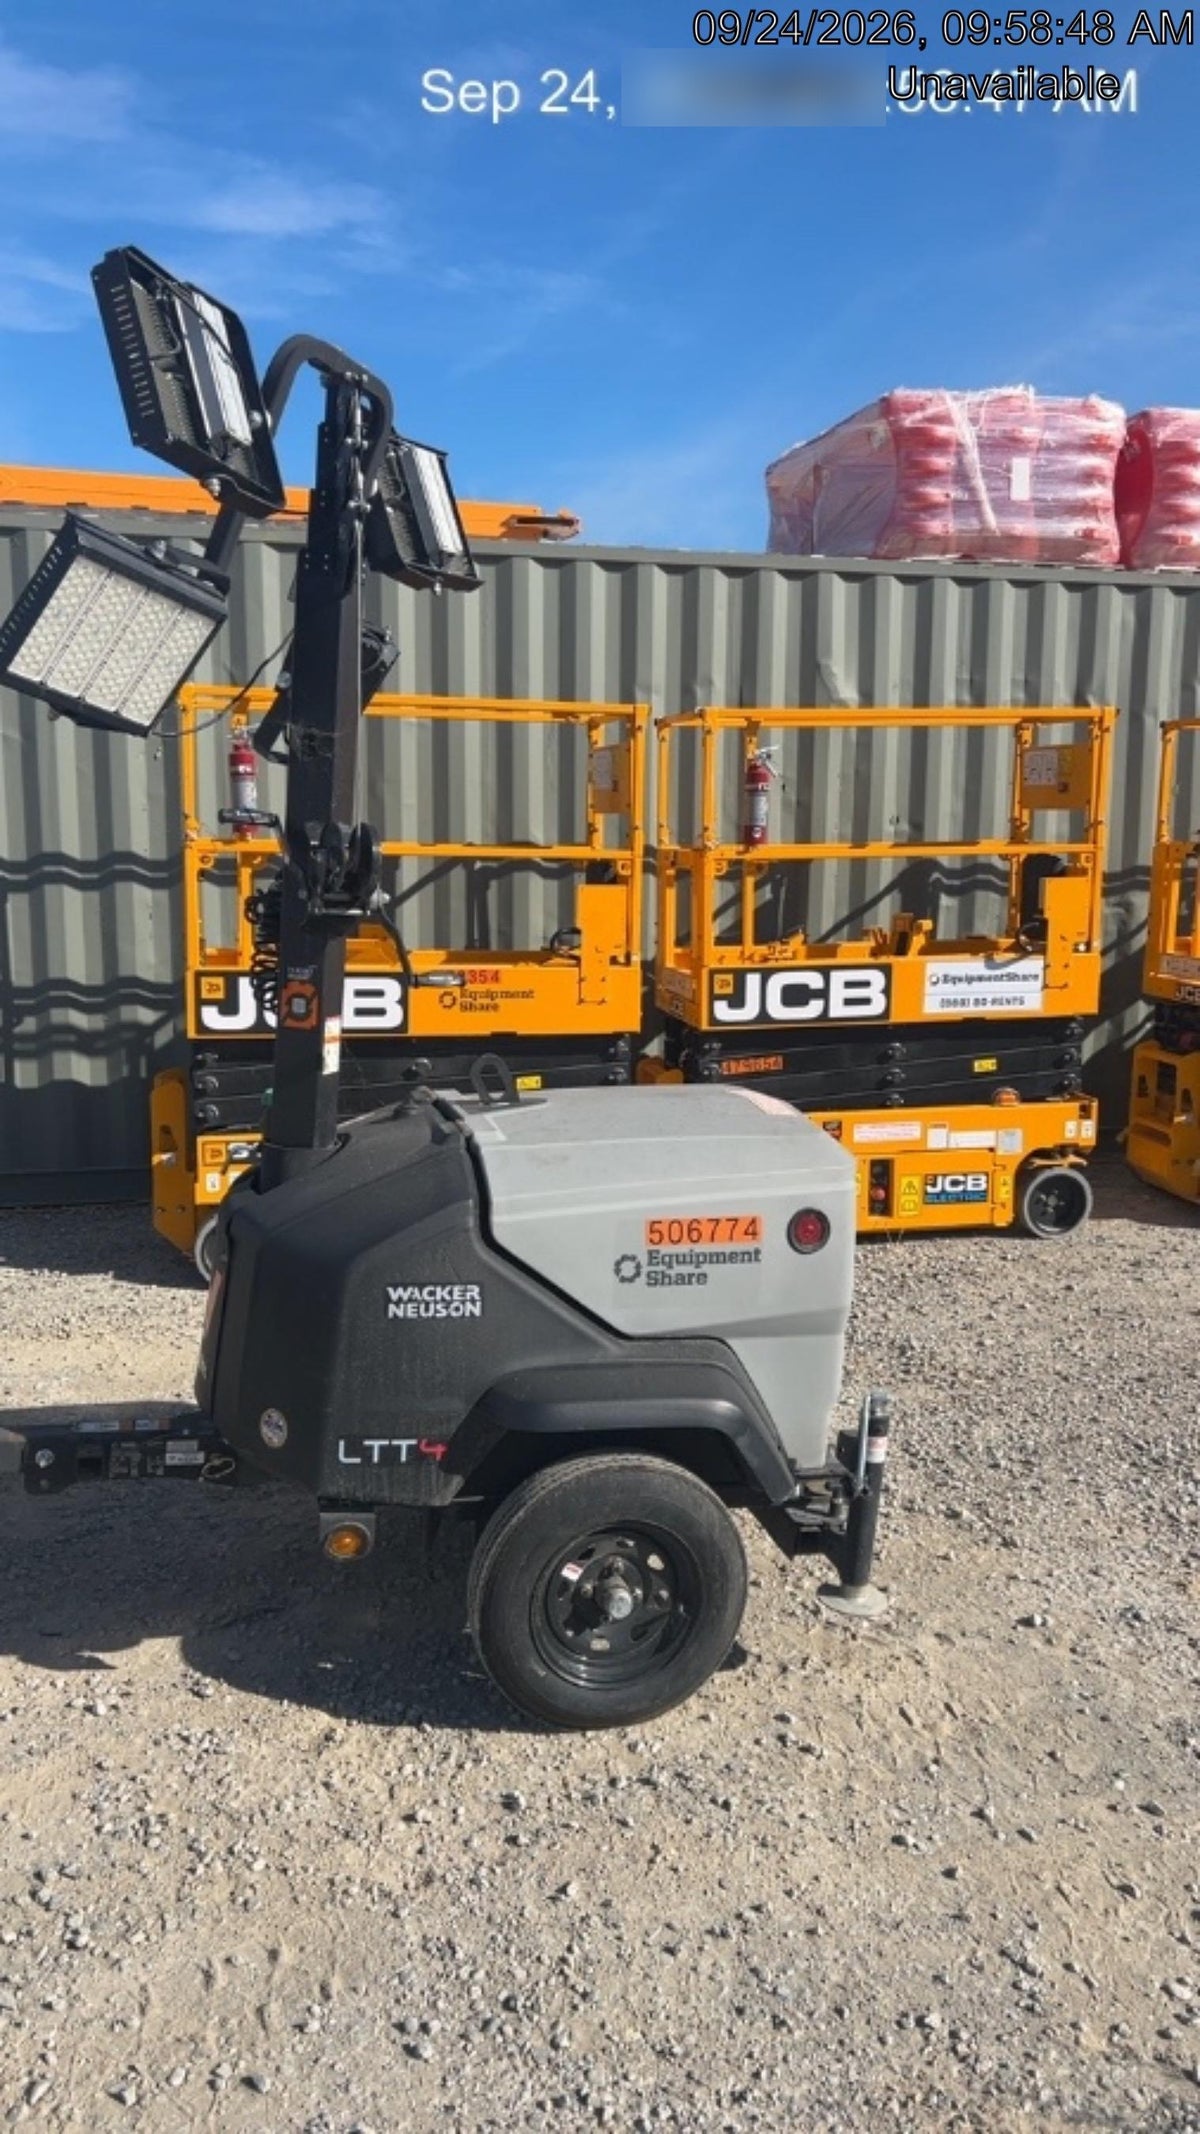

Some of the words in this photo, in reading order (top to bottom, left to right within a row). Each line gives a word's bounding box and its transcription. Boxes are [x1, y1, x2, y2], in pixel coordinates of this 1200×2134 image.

[201, 976, 405, 1030] JB
[459, 988, 535, 1001] Equipment
[713, 969, 887, 1022] JCB
[459, 1001, 499, 1013] Share
[926, 1174, 988, 1193] JCB
[648, 1216, 759, 1246] 506774
[646, 1248, 762, 1269] Equipment
[646, 1270, 708, 1287] Share
[386, 1284, 481, 1301] WACKER
[387, 1301, 482, 1319] NEUSON
[338, 1438, 448, 1464] LTT4
